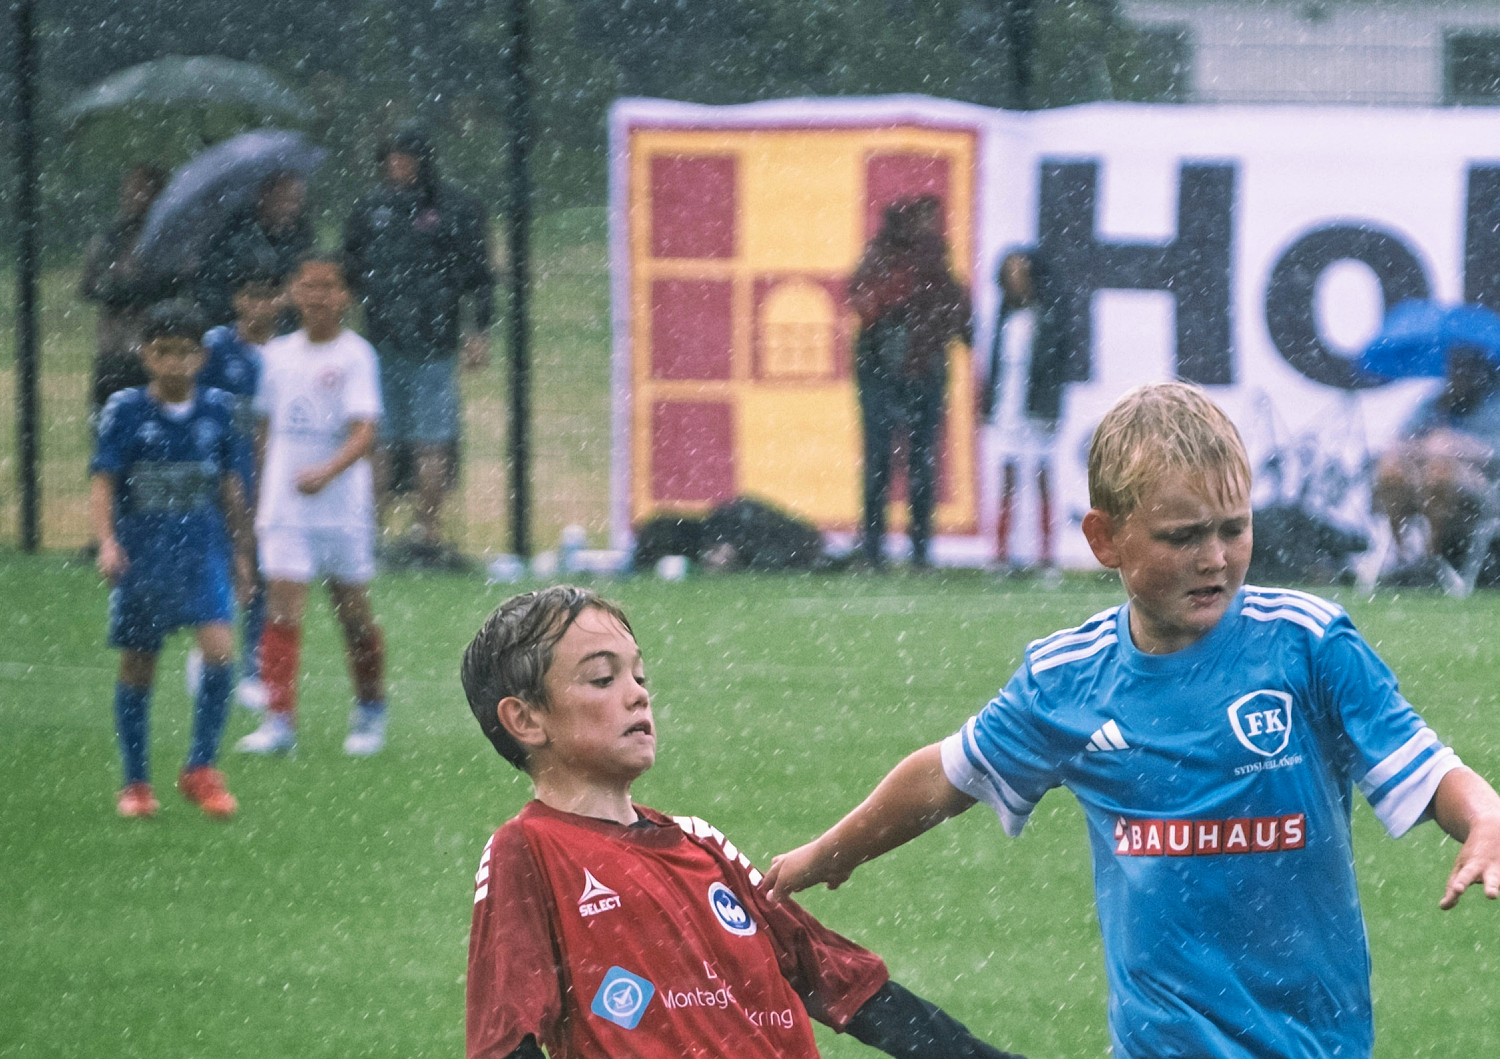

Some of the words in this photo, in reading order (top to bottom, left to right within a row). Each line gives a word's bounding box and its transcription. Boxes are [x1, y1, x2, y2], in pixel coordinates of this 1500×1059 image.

[1244, 708, 1286, 738] FK
[1131, 818, 1303, 851] BAUHAUS
[578, 895, 622, 917] SELECT
